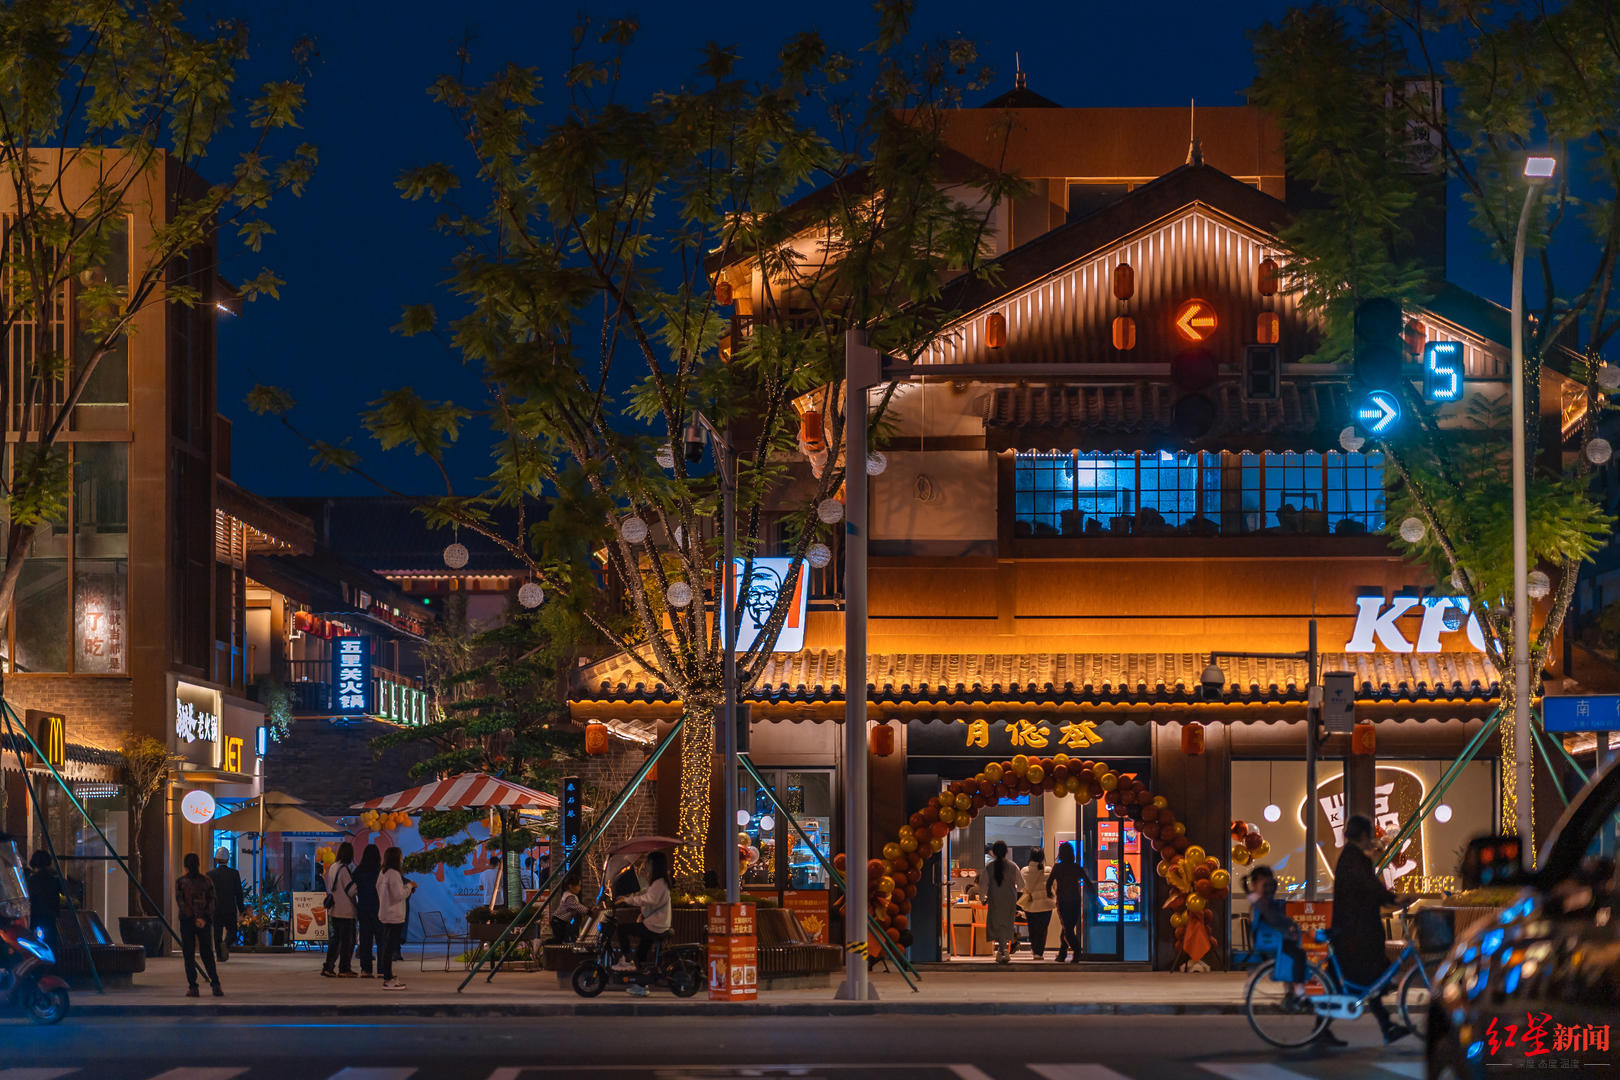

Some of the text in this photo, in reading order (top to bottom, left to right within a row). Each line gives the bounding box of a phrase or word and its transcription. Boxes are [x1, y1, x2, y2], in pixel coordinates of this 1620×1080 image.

[340, 640, 364, 709] 五里关火锅
[223, 735, 244, 774] JET
